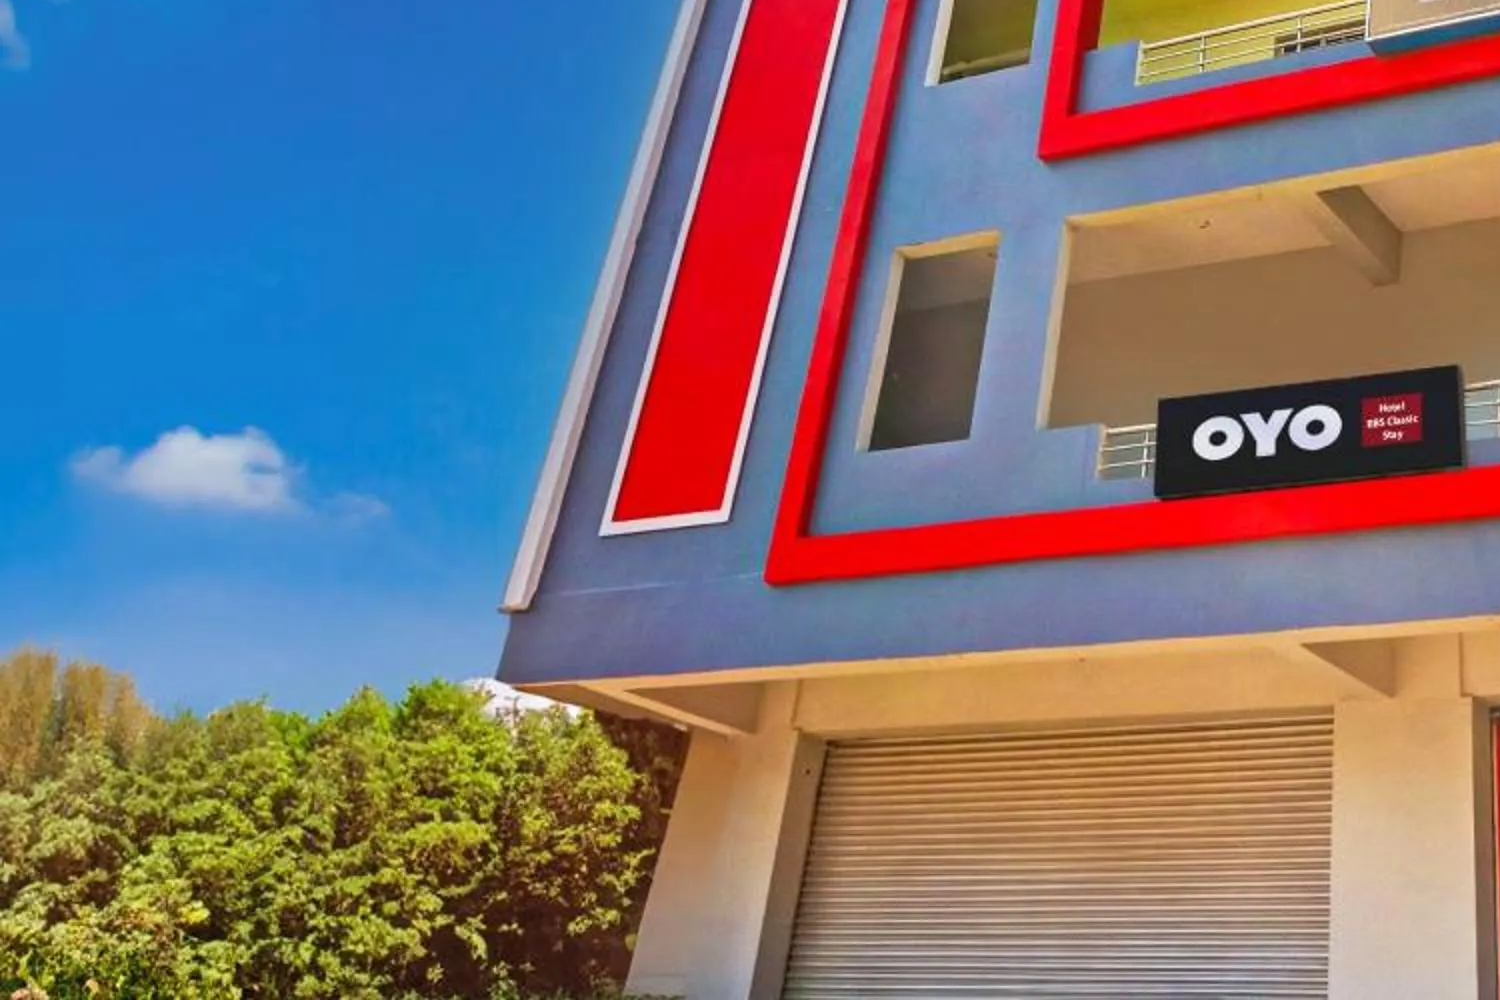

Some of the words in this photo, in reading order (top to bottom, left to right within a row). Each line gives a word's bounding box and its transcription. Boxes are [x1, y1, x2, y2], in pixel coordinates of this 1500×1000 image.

[1379, 400, 1405, 413] Hotel
[1387, 414, 1420, 427] Classic
[1192, 404, 1343, 462] OYO
[1382, 429, 1404, 441] Stay
